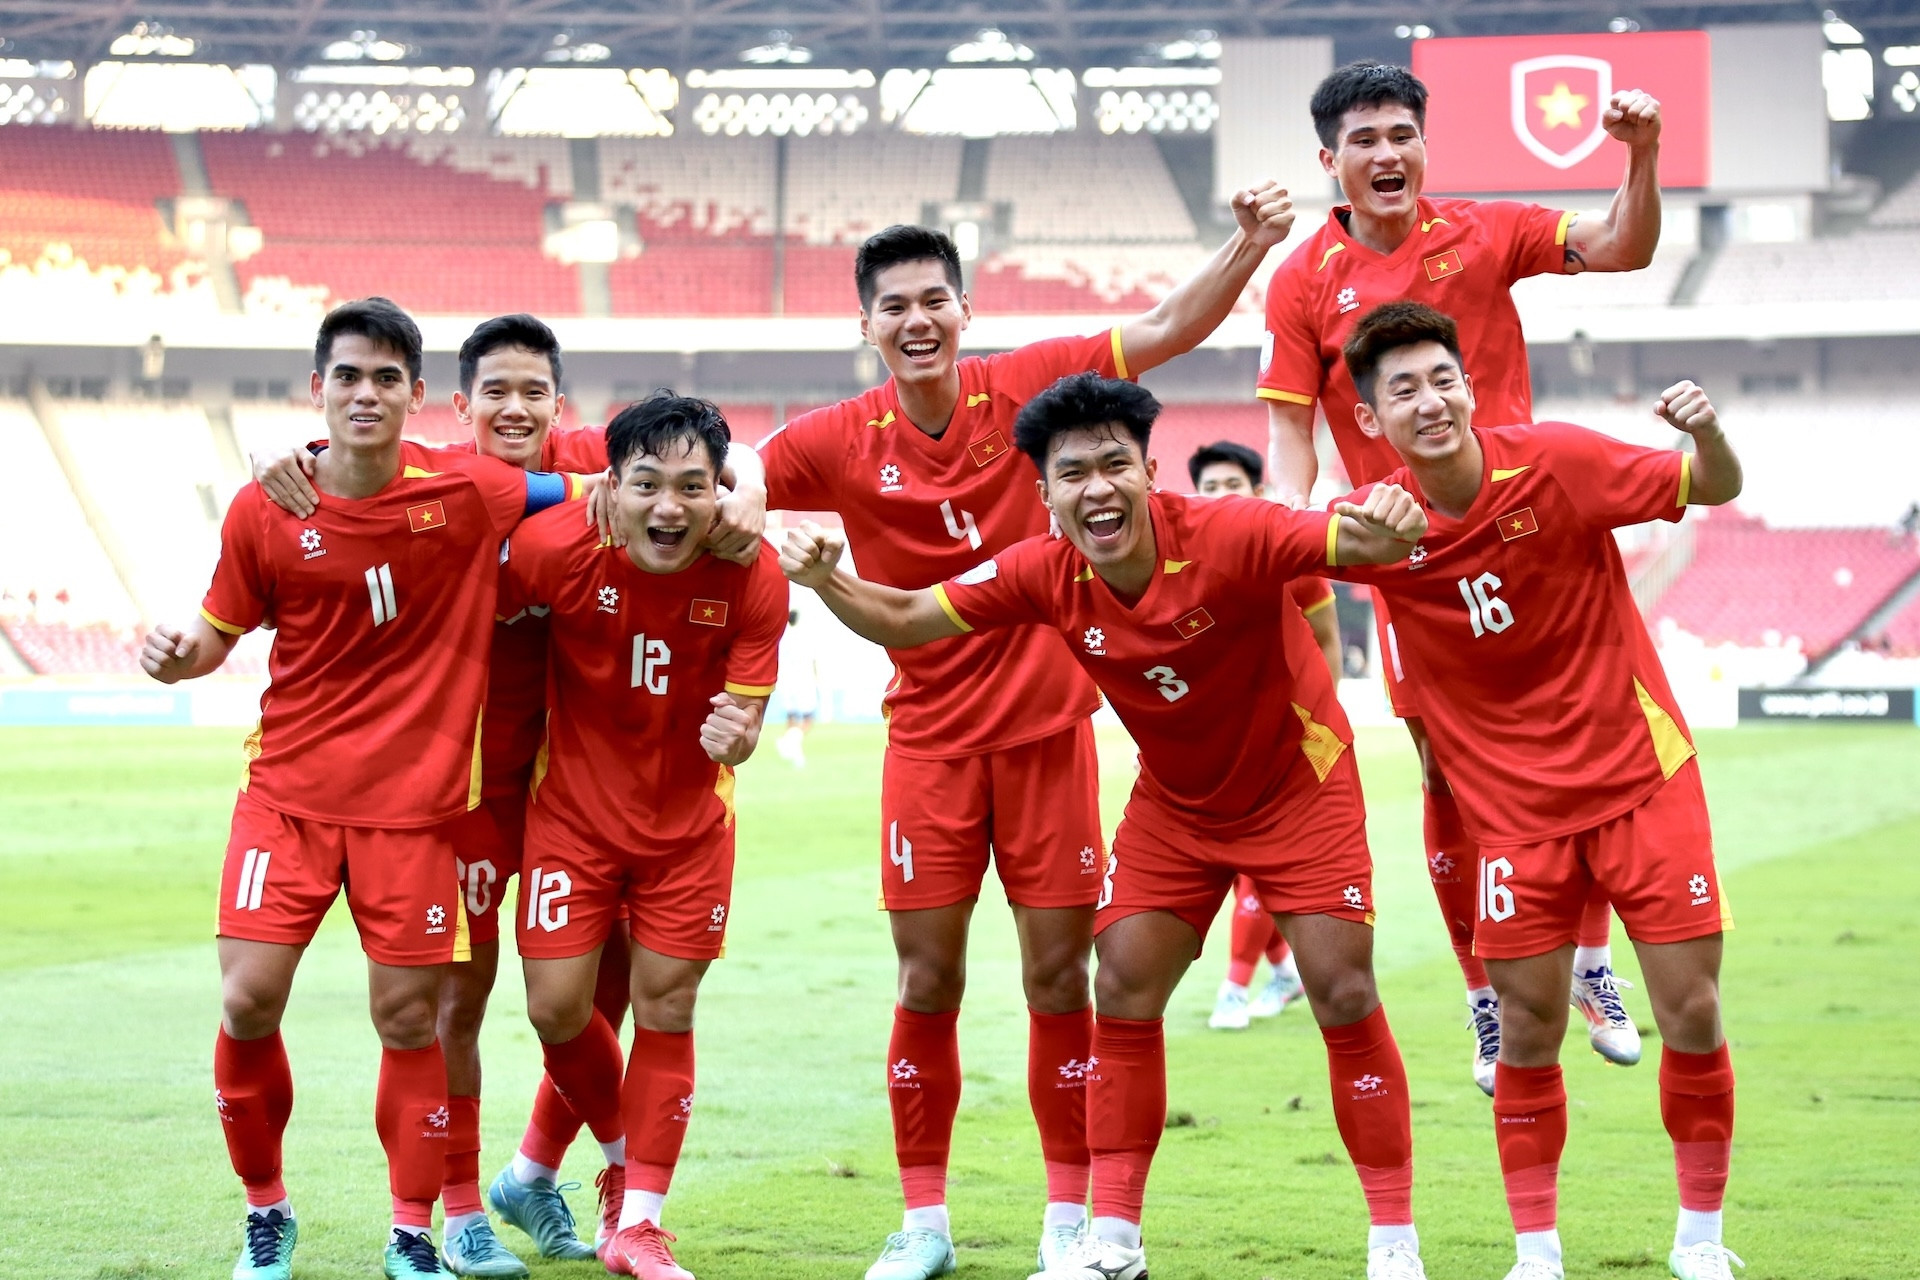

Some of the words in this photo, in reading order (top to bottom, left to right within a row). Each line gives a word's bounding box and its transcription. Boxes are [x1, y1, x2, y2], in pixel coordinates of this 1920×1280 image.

[940, 499, 983, 551] 4
[365, 563, 397, 627] 11
[1457, 571, 1515, 638] 16
[631, 632, 672, 695] 12
[1143, 665, 1189, 703] 3
[236, 847, 271, 912] 11
[889, 819, 914, 882] 4
[526, 866, 573, 933] 12
[1478, 855, 1516, 923] 16
